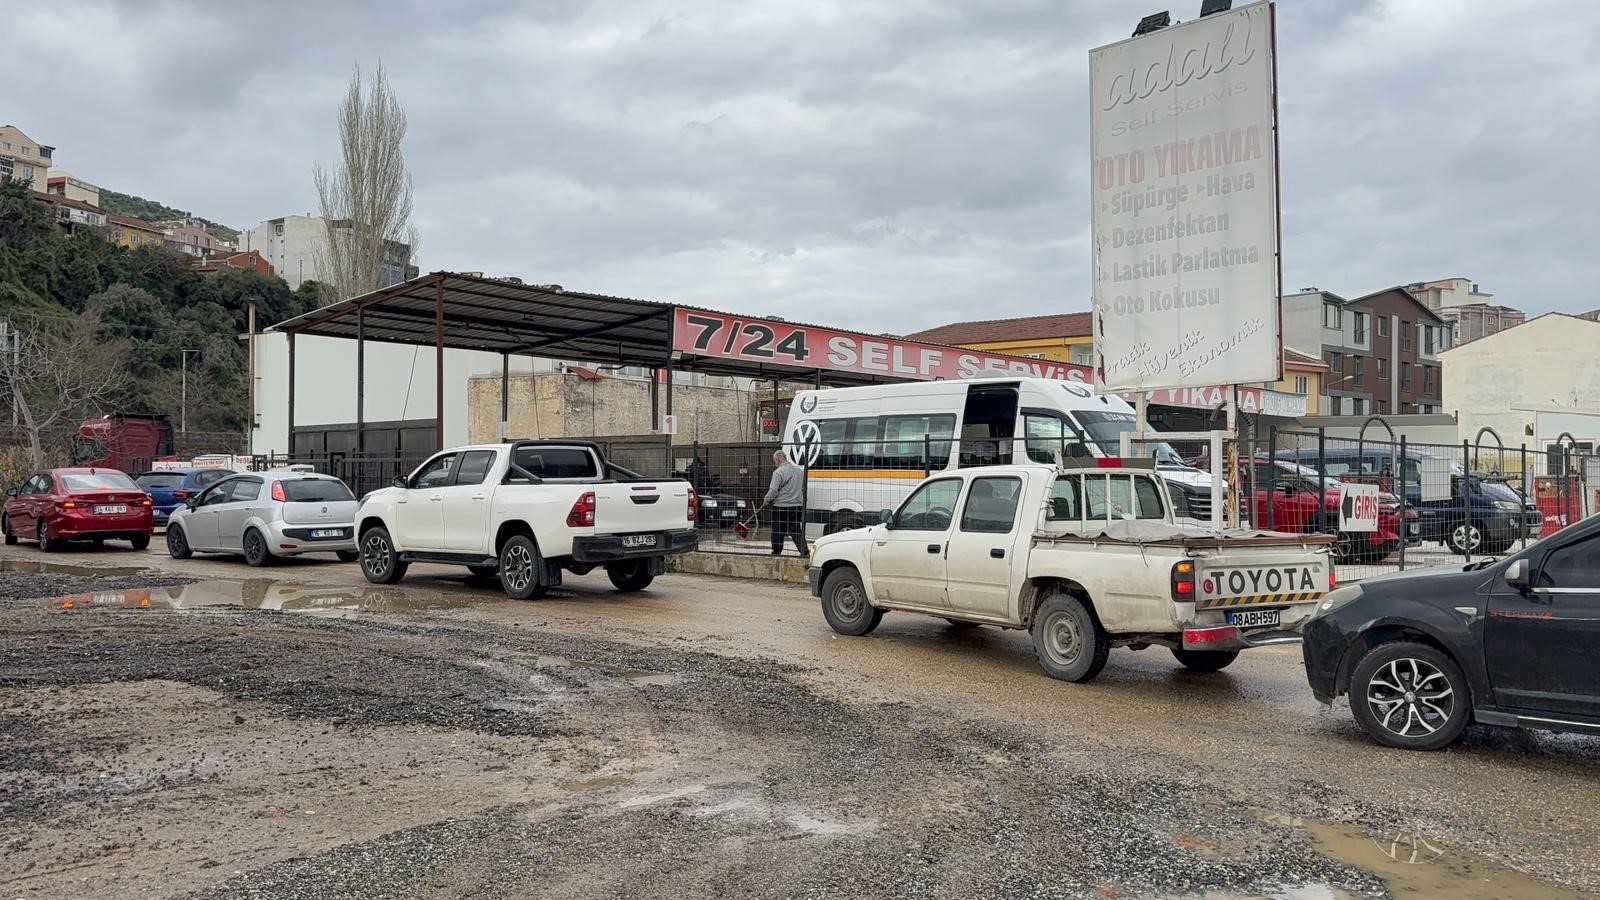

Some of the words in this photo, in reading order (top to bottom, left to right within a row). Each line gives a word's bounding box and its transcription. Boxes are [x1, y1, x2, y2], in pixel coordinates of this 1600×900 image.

[1111, 107, 1158, 137] Self
[1167, 81, 1248, 117] Servis
[1099, 150, 1145, 190] OTO
[1153, 124, 1262, 178] YIKAMA
[1111, 184, 1188, 217] Süpürge
[1207, 172, 1255, 197] Hava
[1112, 213, 1230, 248] Dezenfektan
[1113, 253, 1167, 283] Lastik
[1172, 244, 1259, 274] Parlatma
[1113, 294, 1145, 316] Oto
[1150, 287, 1220, 313] Kokusu
[686, 313, 809, 362] 7/24
[827, 336, 943, 376] SELF
[1167, 388, 1257, 411] YIKAA
[1137, 329, 1205, 380] Hijyenik
[1178, 316, 1265, 378] Ekonomik
[665, 416, 673, 433] 1
[1211, 567, 1315, 595] TOYOTA
